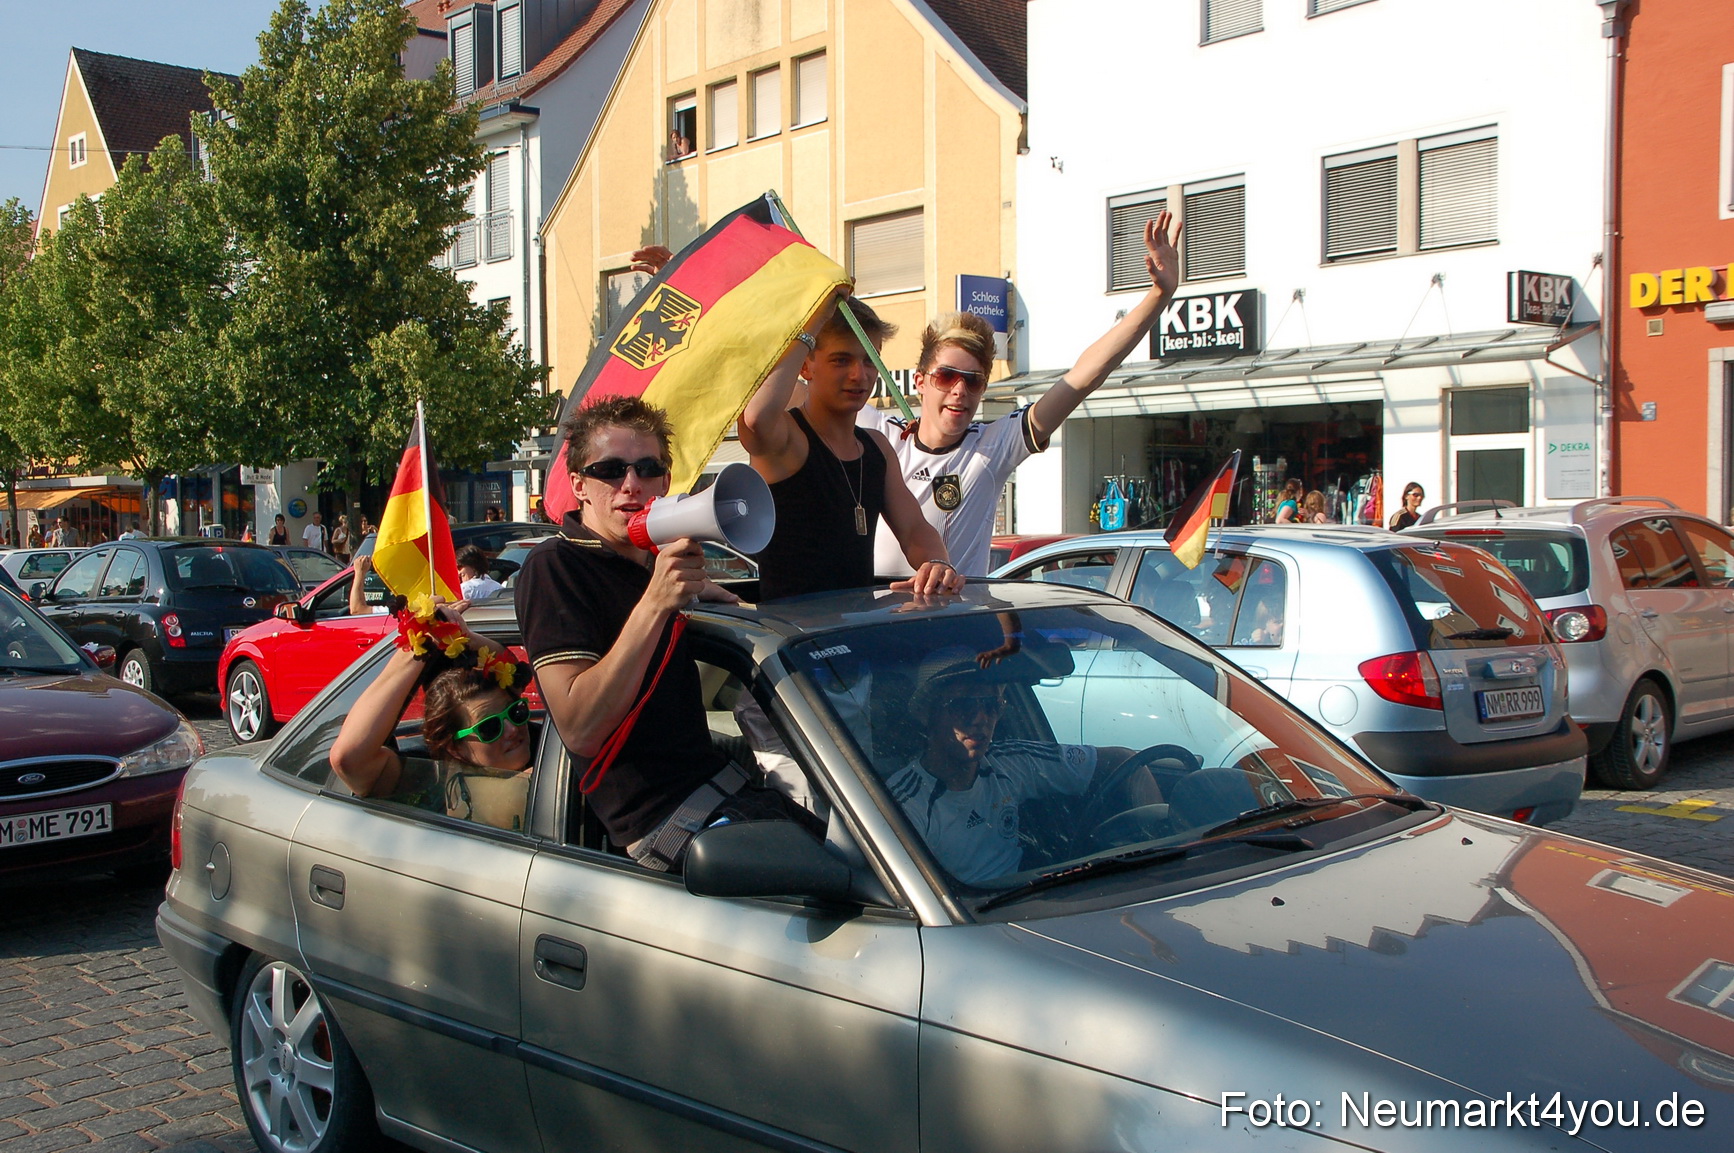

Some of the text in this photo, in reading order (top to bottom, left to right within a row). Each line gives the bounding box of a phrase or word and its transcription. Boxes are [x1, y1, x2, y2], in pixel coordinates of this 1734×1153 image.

[972, 290, 1000, 304] Schloss
[1524, 274, 1571, 305] KBK
[1630, 267, 1713, 308] DER
[966, 303, 1005, 317] Apotheke
[1160, 293, 1243, 335] KBK
[1560, 442, 1591, 452] DEKRA
[1486, 690, 1540, 715] NM RR 999
[29, 815, 61, 840] ME
[66, 808, 108, 833] 791
